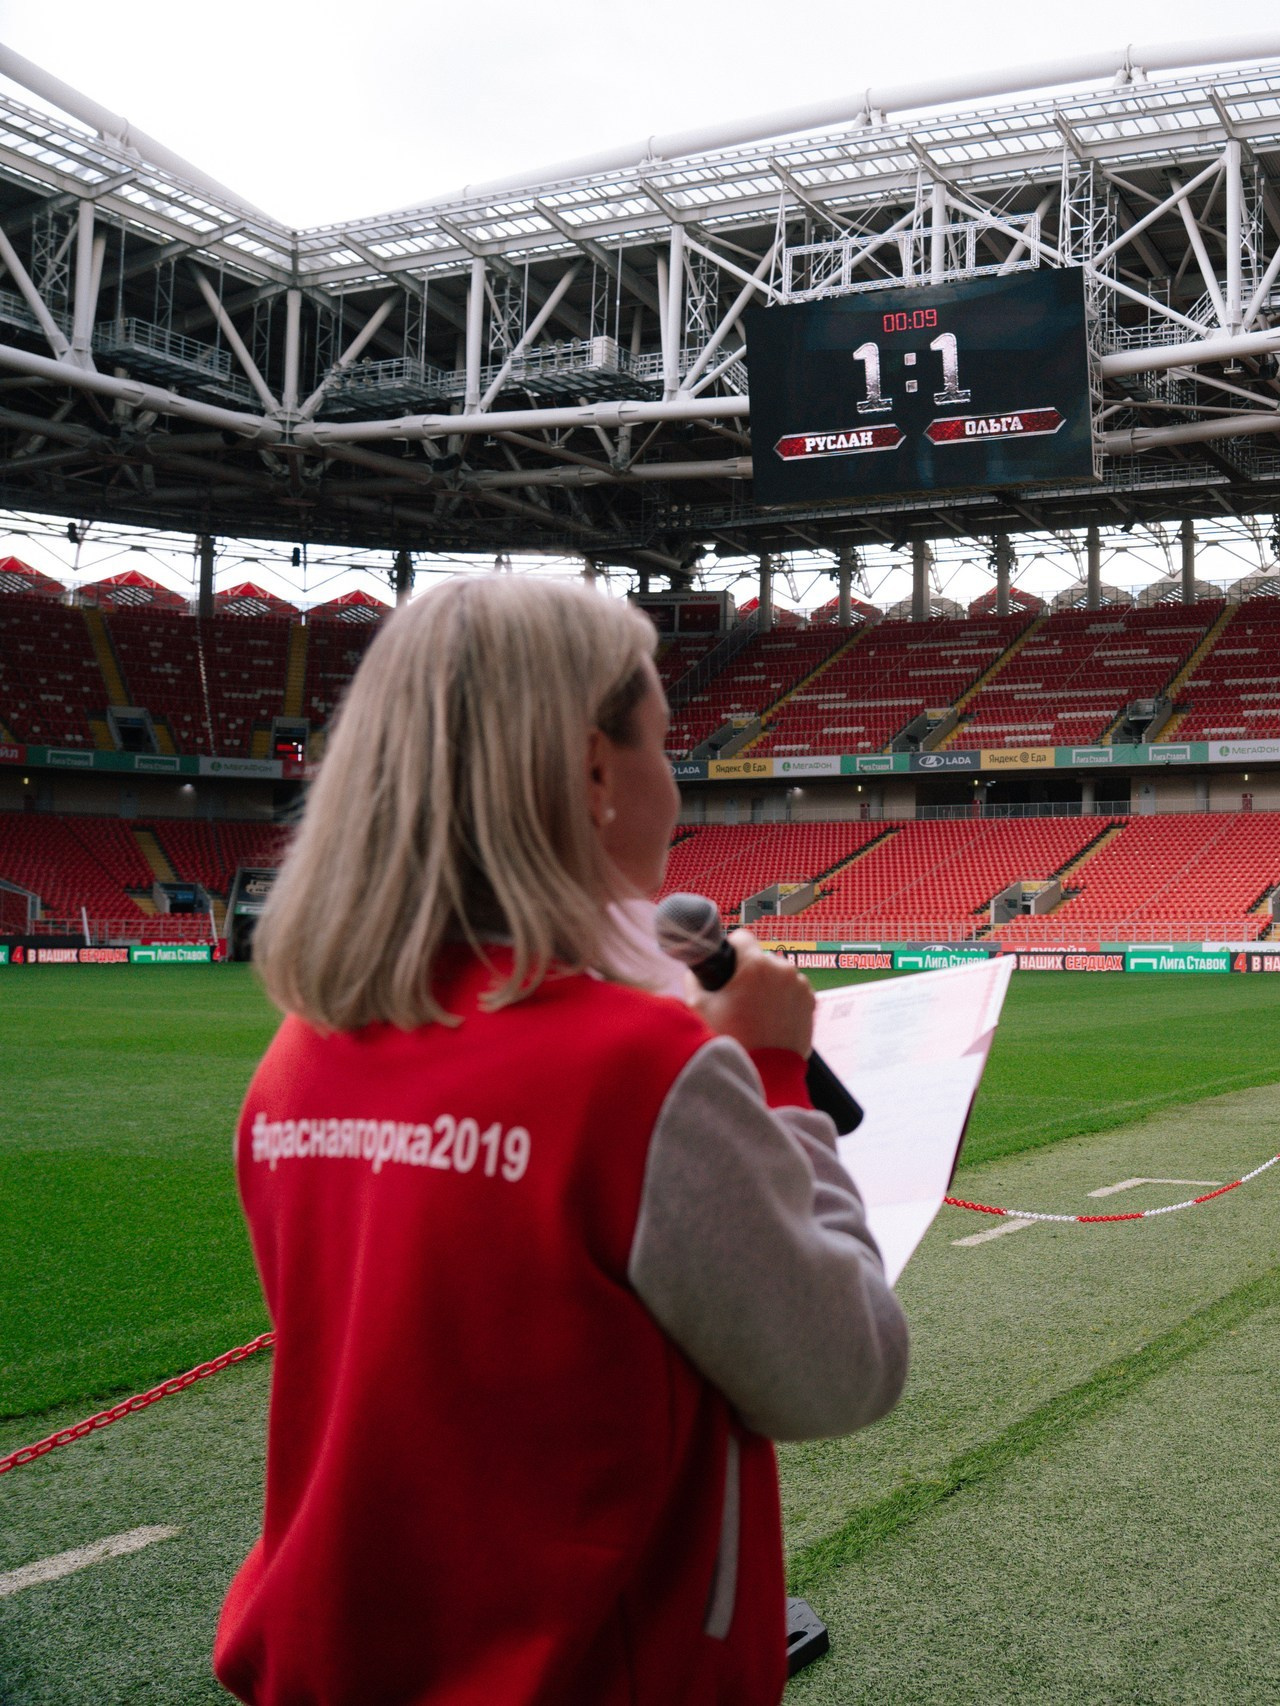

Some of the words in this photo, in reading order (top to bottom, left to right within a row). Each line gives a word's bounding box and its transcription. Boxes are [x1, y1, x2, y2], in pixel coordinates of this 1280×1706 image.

[883, 309, 938, 333] 00:09
[965, 416, 1023, 436] ОЛЬГА
[805, 431, 873, 452] РУСЛАН
[946, 756, 971, 765] LADA
[989, 754, 1018, 763] Яндекс
[1031, 753, 1047, 762] Еда
[677, 766, 700, 774] LADA
[715, 765, 741, 773] Яндекс
[752, 763, 766, 771] Еда
[797, 953, 838, 968] НАШИХ
[838, 953, 892, 969] СЕРДЦАХ
[1019, 954, 1064, 970] НАШИХ
[1065, 954, 1123, 971] СЕРДЦАХ
[1251, 955, 1261, 972] В
